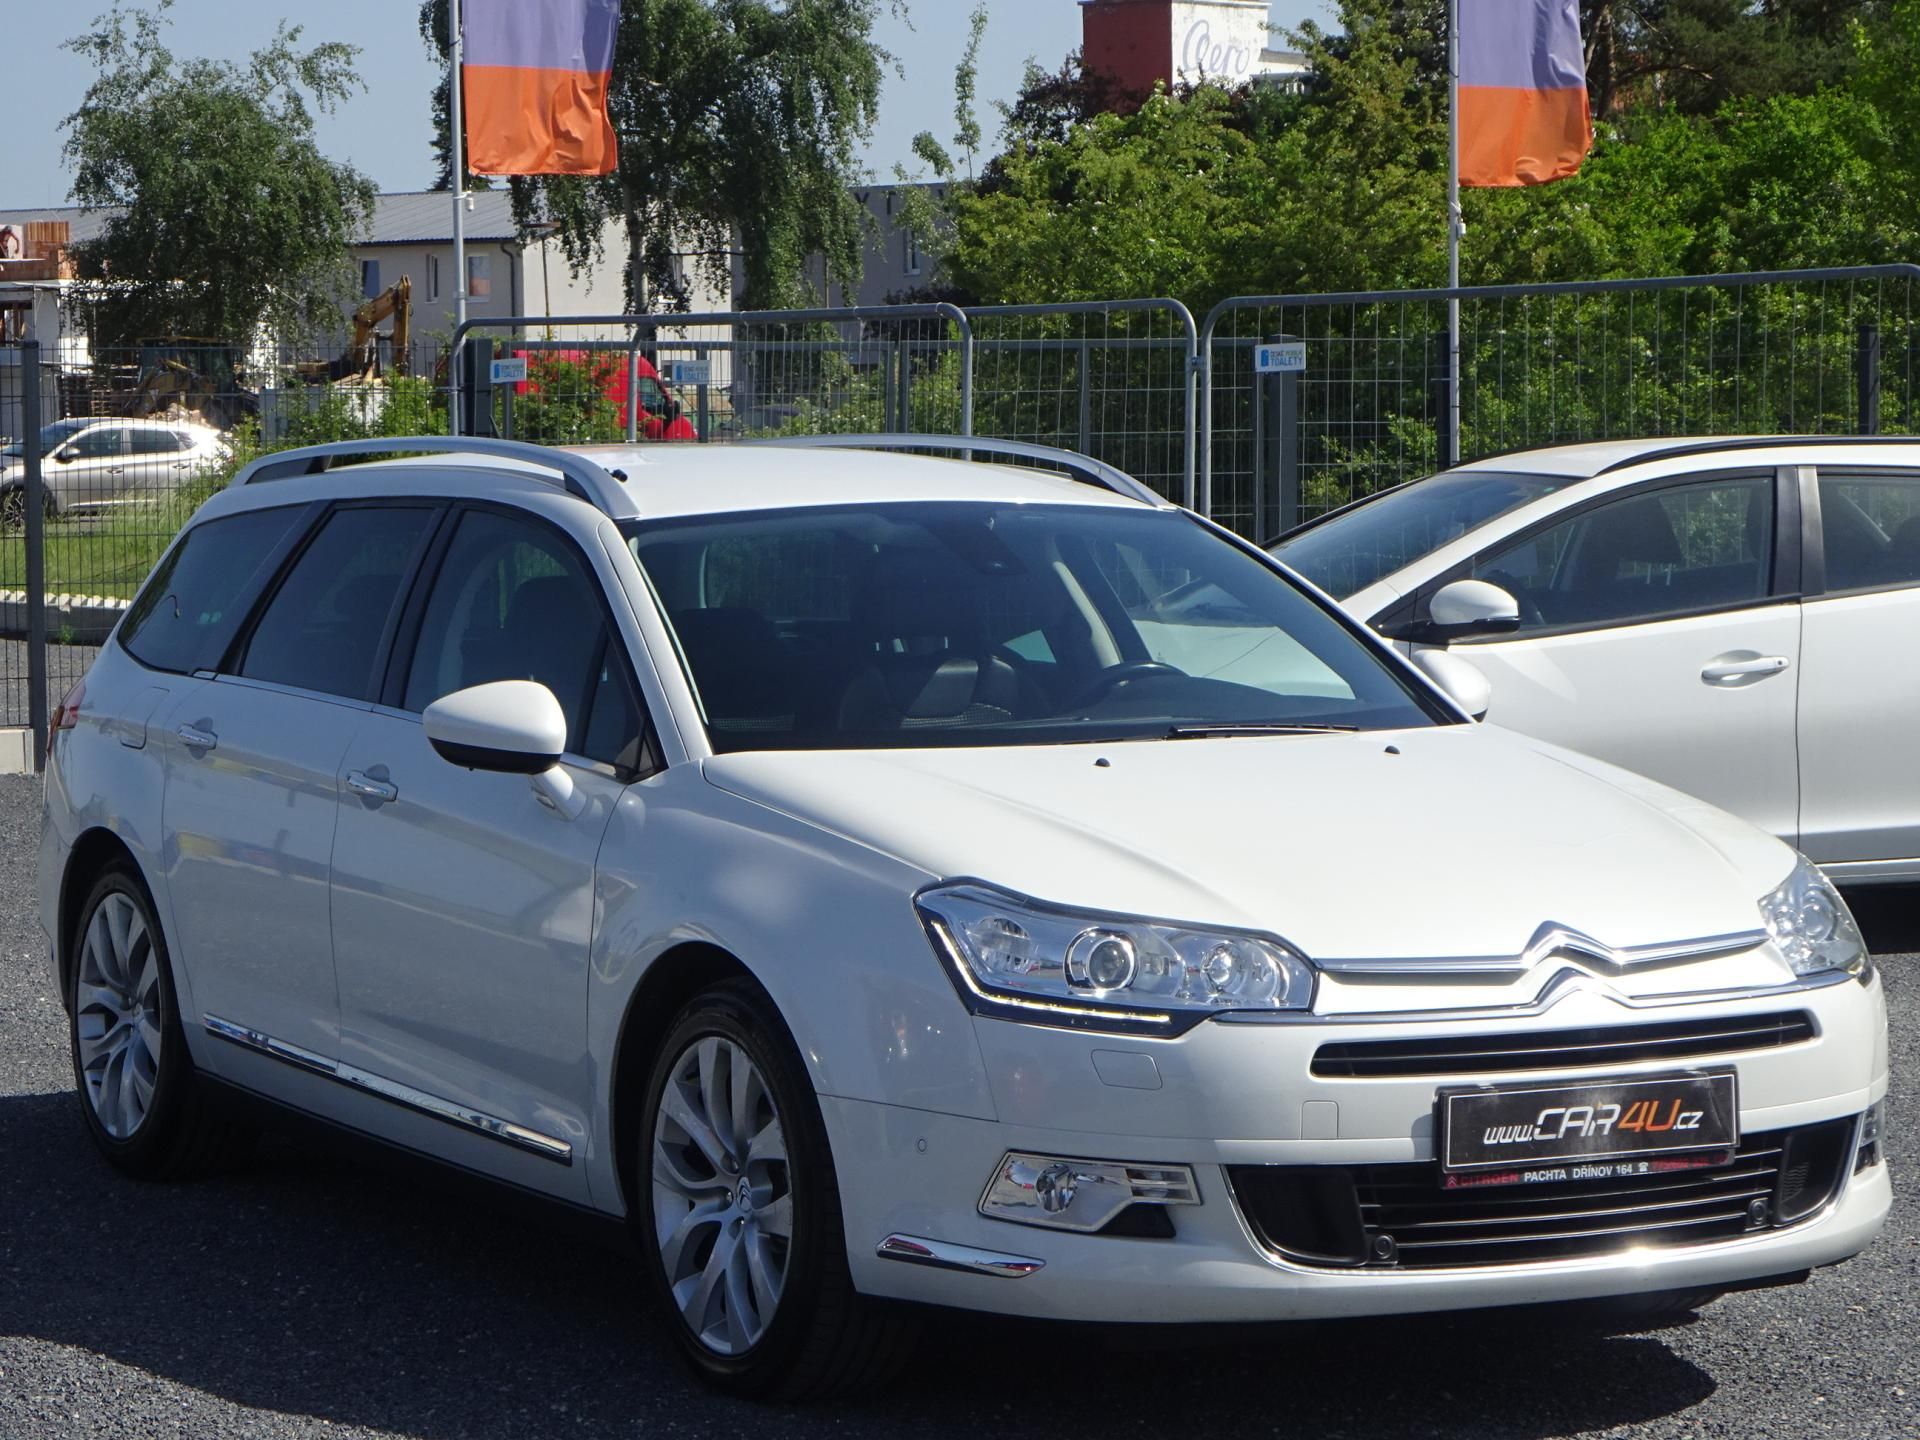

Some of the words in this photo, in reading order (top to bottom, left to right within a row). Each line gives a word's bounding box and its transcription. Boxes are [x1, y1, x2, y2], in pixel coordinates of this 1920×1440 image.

[1270, 356, 1303, 367] TOALETY
[1483, 1098, 1704, 1145] www.CAR4U.cz
[1524, 1168, 1567, 1182] PACHTA
[1572, 1164, 1613, 1178] DŘÍNOV
[1616, 1164, 1633, 1174] 164
